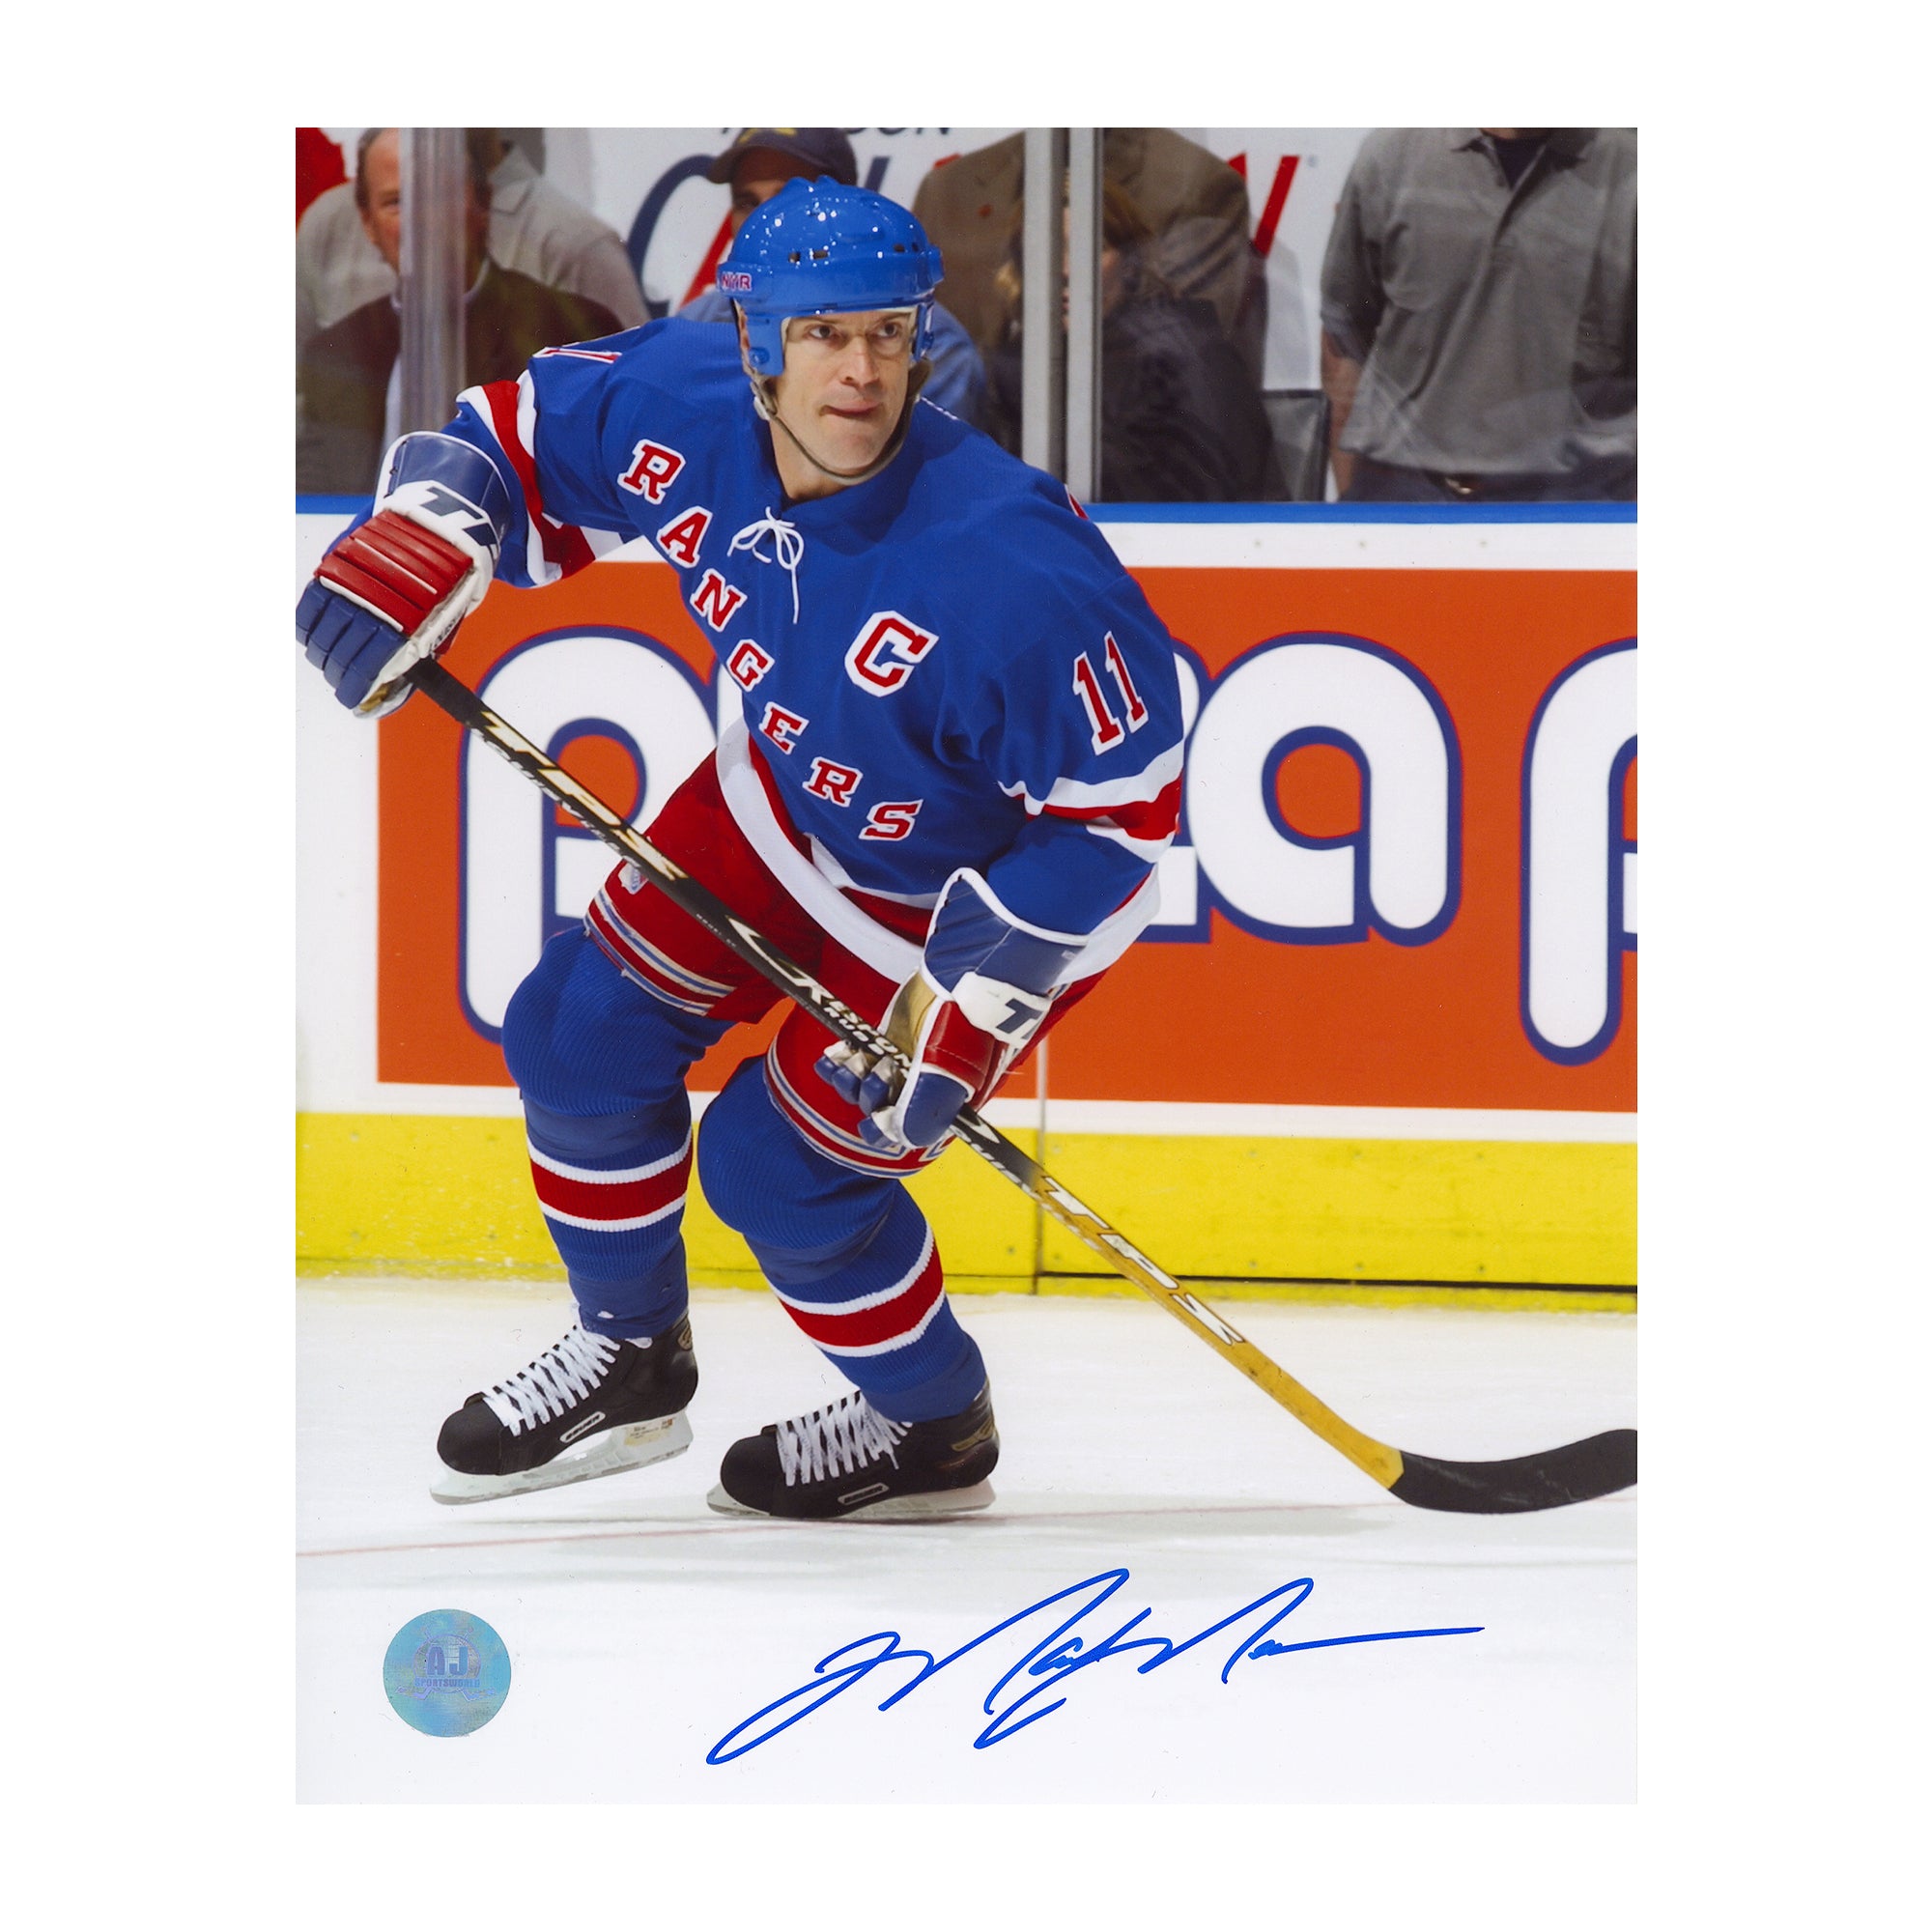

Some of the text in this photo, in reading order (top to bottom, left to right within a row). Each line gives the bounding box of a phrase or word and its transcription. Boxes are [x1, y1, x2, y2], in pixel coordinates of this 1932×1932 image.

[617, 439, 924, 841] RANGERS
[844, 610, 941, 697] C
[1072, 630, 1150, 756] 11
[481, 711, 689, 881] TPS
[949, 1123, 1103, 1246] OUISVILLE
[1041, 1176, 1245, 1347] TPS
[426, 1644, 469, 1676] AJ
